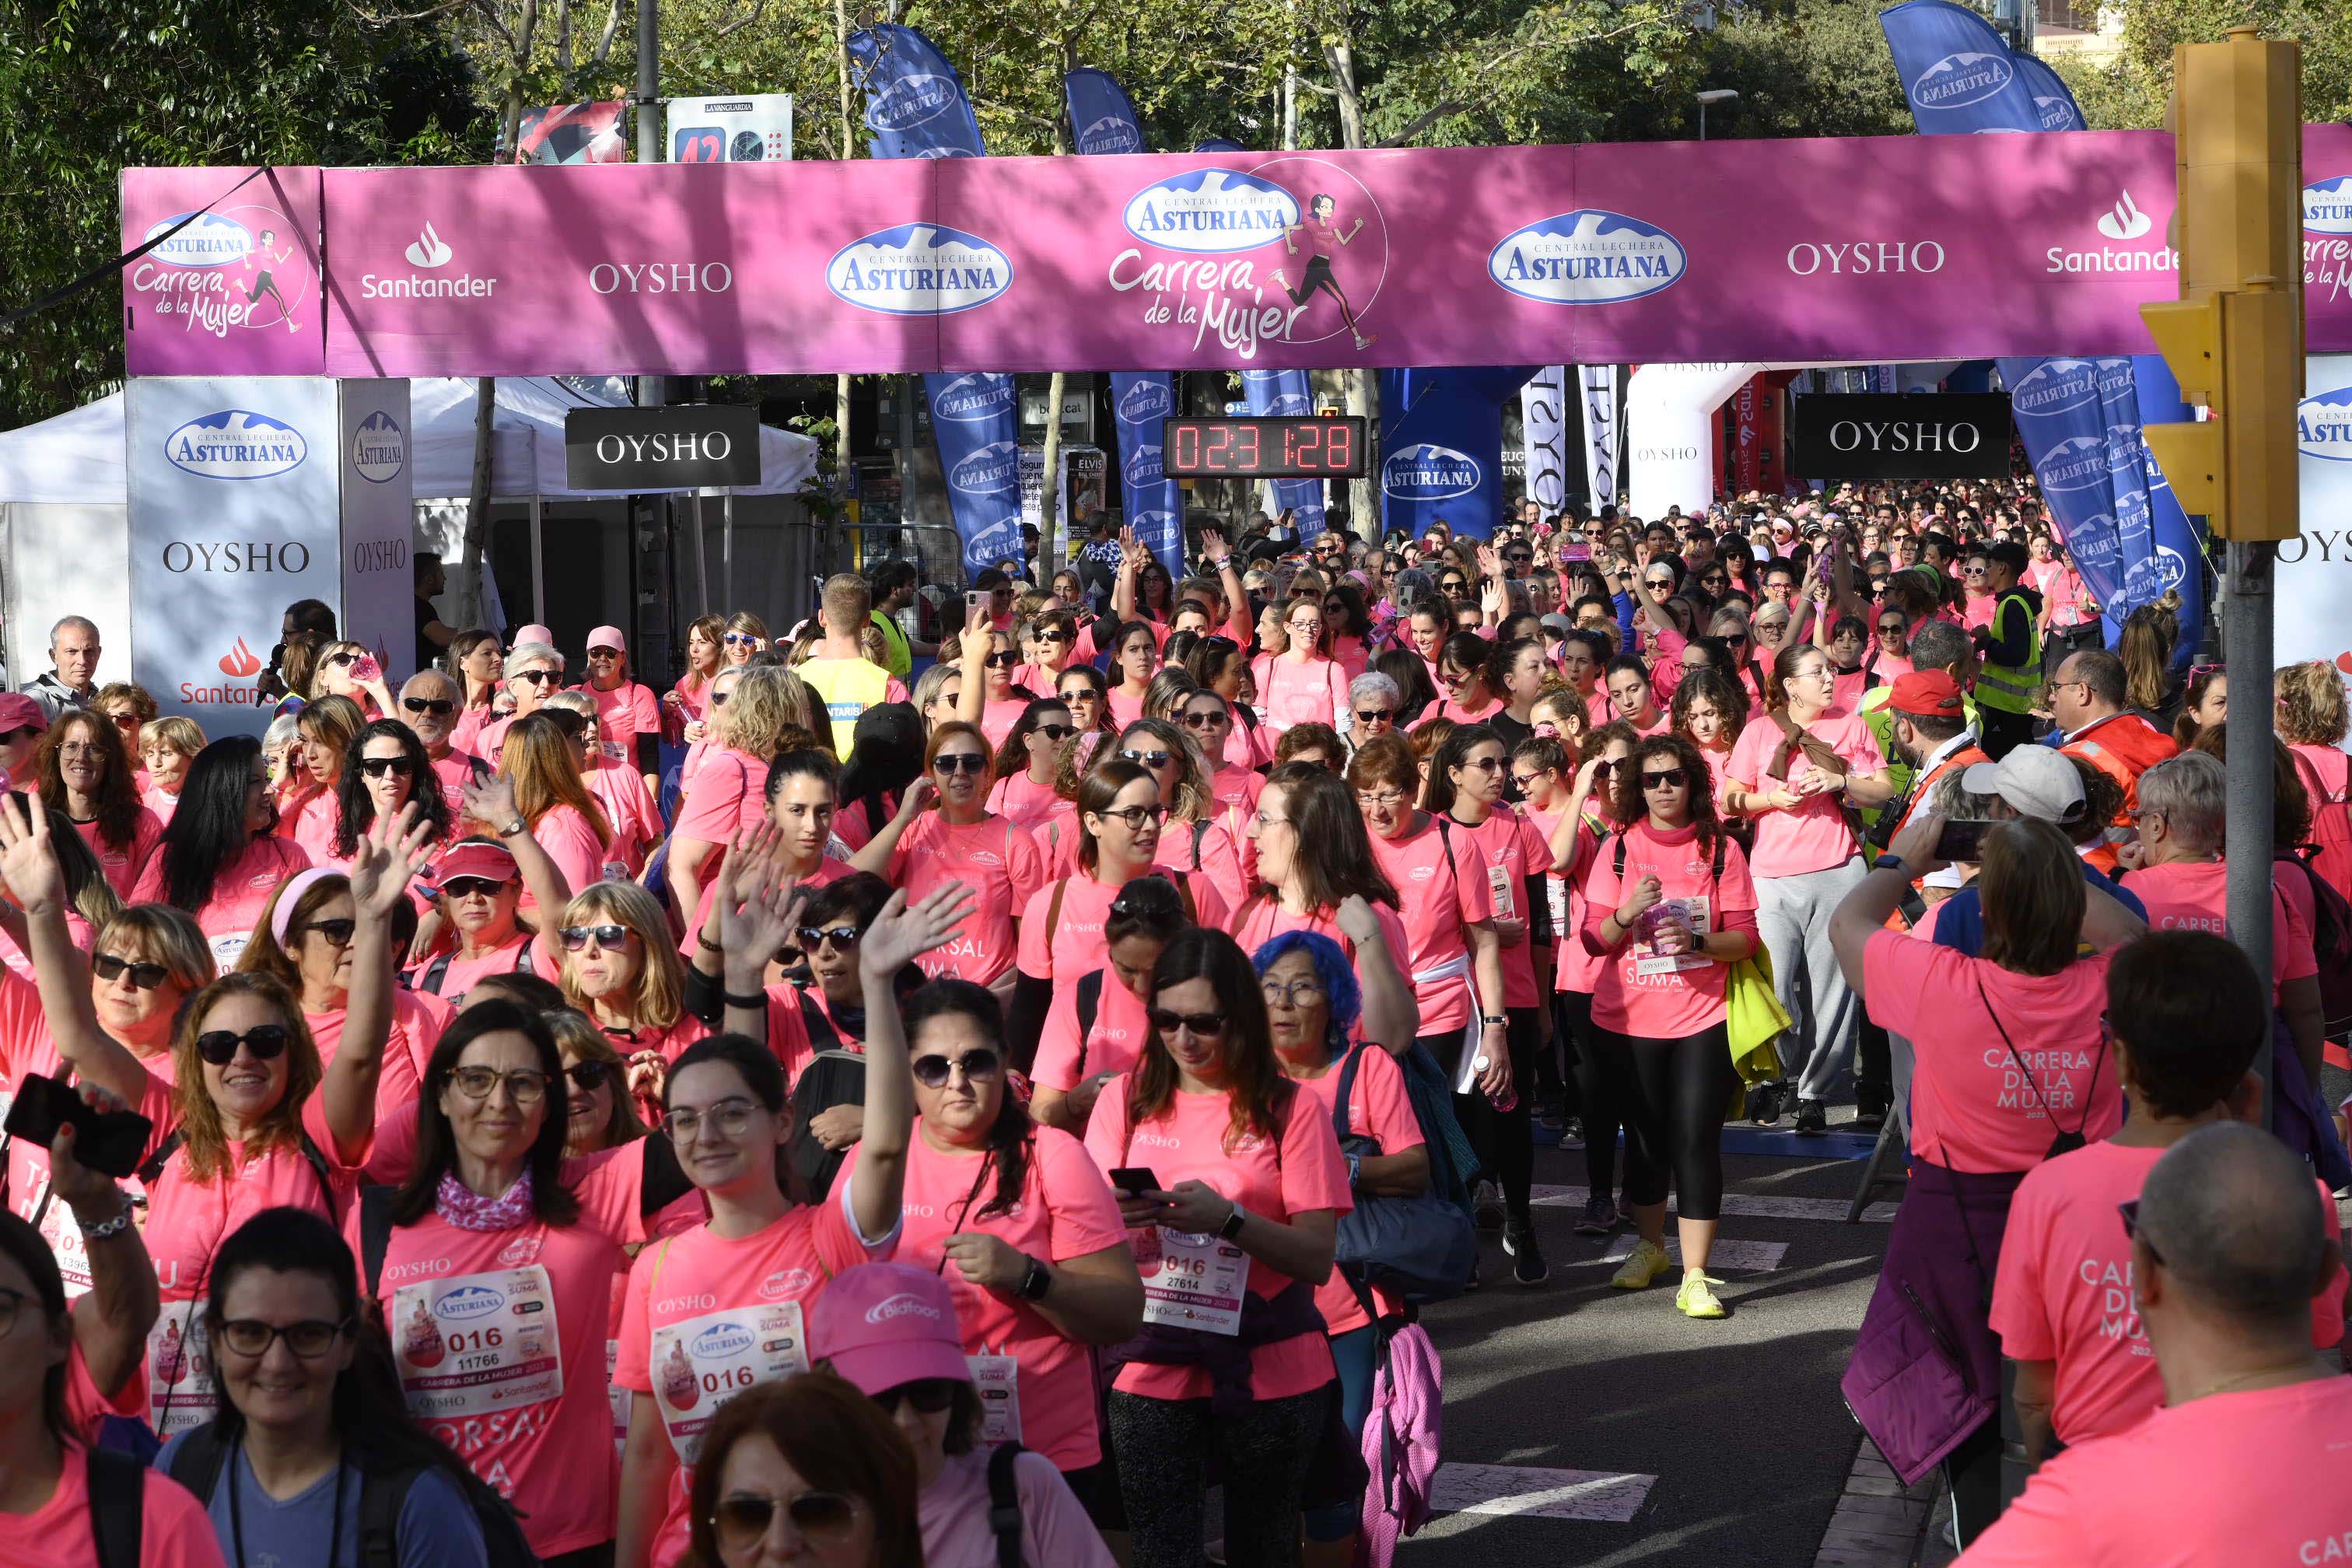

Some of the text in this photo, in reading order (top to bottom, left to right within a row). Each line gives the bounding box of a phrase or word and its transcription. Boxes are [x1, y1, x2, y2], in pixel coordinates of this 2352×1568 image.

[1164, 196, 1282, 206] CENTRAL LECHERA
[1137, 201, 1287, 233] ASTURIANA
[1535, 242, 1664, 253] CENTRAL LECHERA
[869, 254, 992, 264] CENTRAL LECHERA
[1503, 246, 1671, 282] ASTURIANA
[1787, 242, 1945, 275] OYSHO
[2046, 247, 2179, 273] Santande
[133, 263, 225, 292] Carrera
[589, 262, 732, 294] OYSHO
[840, 255, 999, 291] ASTURIANA
[1109, 248, 1255, 292] Carrera
[2319, 263, 2333, 284] la
[361, 274, 497, 298] Santander
[156, 289, 260, 338] de la Mujer
[1144, 287, 1308, 359] de la Mujer
[596, 431, 732, 464] OYSHO
[1829, 421, 1981, 453] OYSHO
[175, 436, 298, 461] ASTURIANA
[356, 437, 402, 465] ASTURIANA
[1638, 446, 1697, 462] OYSHO
[1079, 459, 1102, 469] ELVIS
[1020, 474, 1033, 483] que
[1020, 482, 1045, 493] quiere
[1384, 468, 1472, 488] ASTURIANA
[1022, 502, 1036, 511] este
[163, 542, 310, 574] OYSHO
[354, 539, 405, 574] OYSHO
[1626, 968, 1684, 987] SUMA
[1983, 1048, 2091, 1069] CARRERA
[2004, 1070, 2072, 1090] DE LA
[1997, 1090, 2075, 1108] MUJER
[901, 1203, 933, 1217] SHO
[387, 1257, 452, 1280] OYSHO
[1167, 1255, 1206, 1276] 016
[508, 1284, 539, 1295] SUMA
[1167, 1276, 1199, 1291] 27614
[441, 1298, 499, 1315] ASTURIANA
[657, 1294, 716, 1314] OYSHO
[759, 1320, 791, 1332] SUMA
[1146, 1306, 1230, 1325] SHO Santander
[449, 1327, 502, 1353] 016
[698, 1334, 751, 1353] ASTURIANA
[458, 1353, 499, 1370] 11766
[464, 1376, 477, 1384] DE
[478, 1374, 491, 1382] LA
[702, 1366, 754, 1393] 016
[420, 1379, 551, 1407] OYSHO Santander
[163, 1415, 200, 1425] OYSHO
